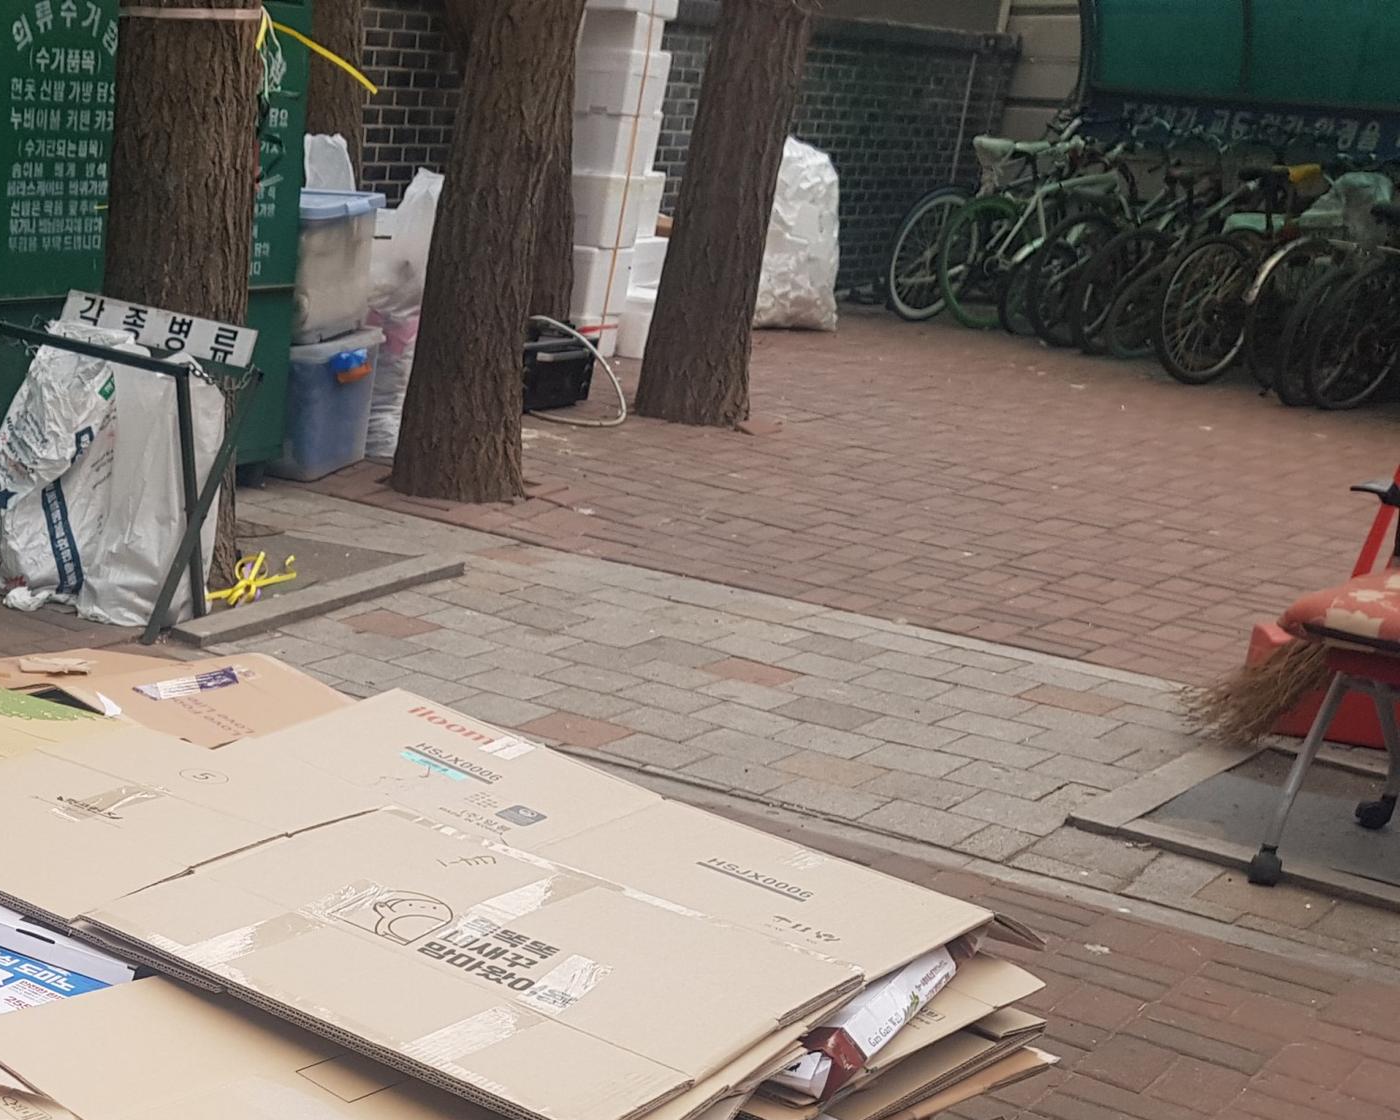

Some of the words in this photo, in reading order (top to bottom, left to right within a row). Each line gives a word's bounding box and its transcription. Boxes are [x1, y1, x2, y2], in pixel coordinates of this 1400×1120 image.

[29, 46, 102, 75] (수거품목)
[407, 705, 496, 746] iloom
[415, 742, 503, 783] HSJX0006
[706, 857, 815, 900] HSJX0006
[12, 962, 76, 993] 도미노
